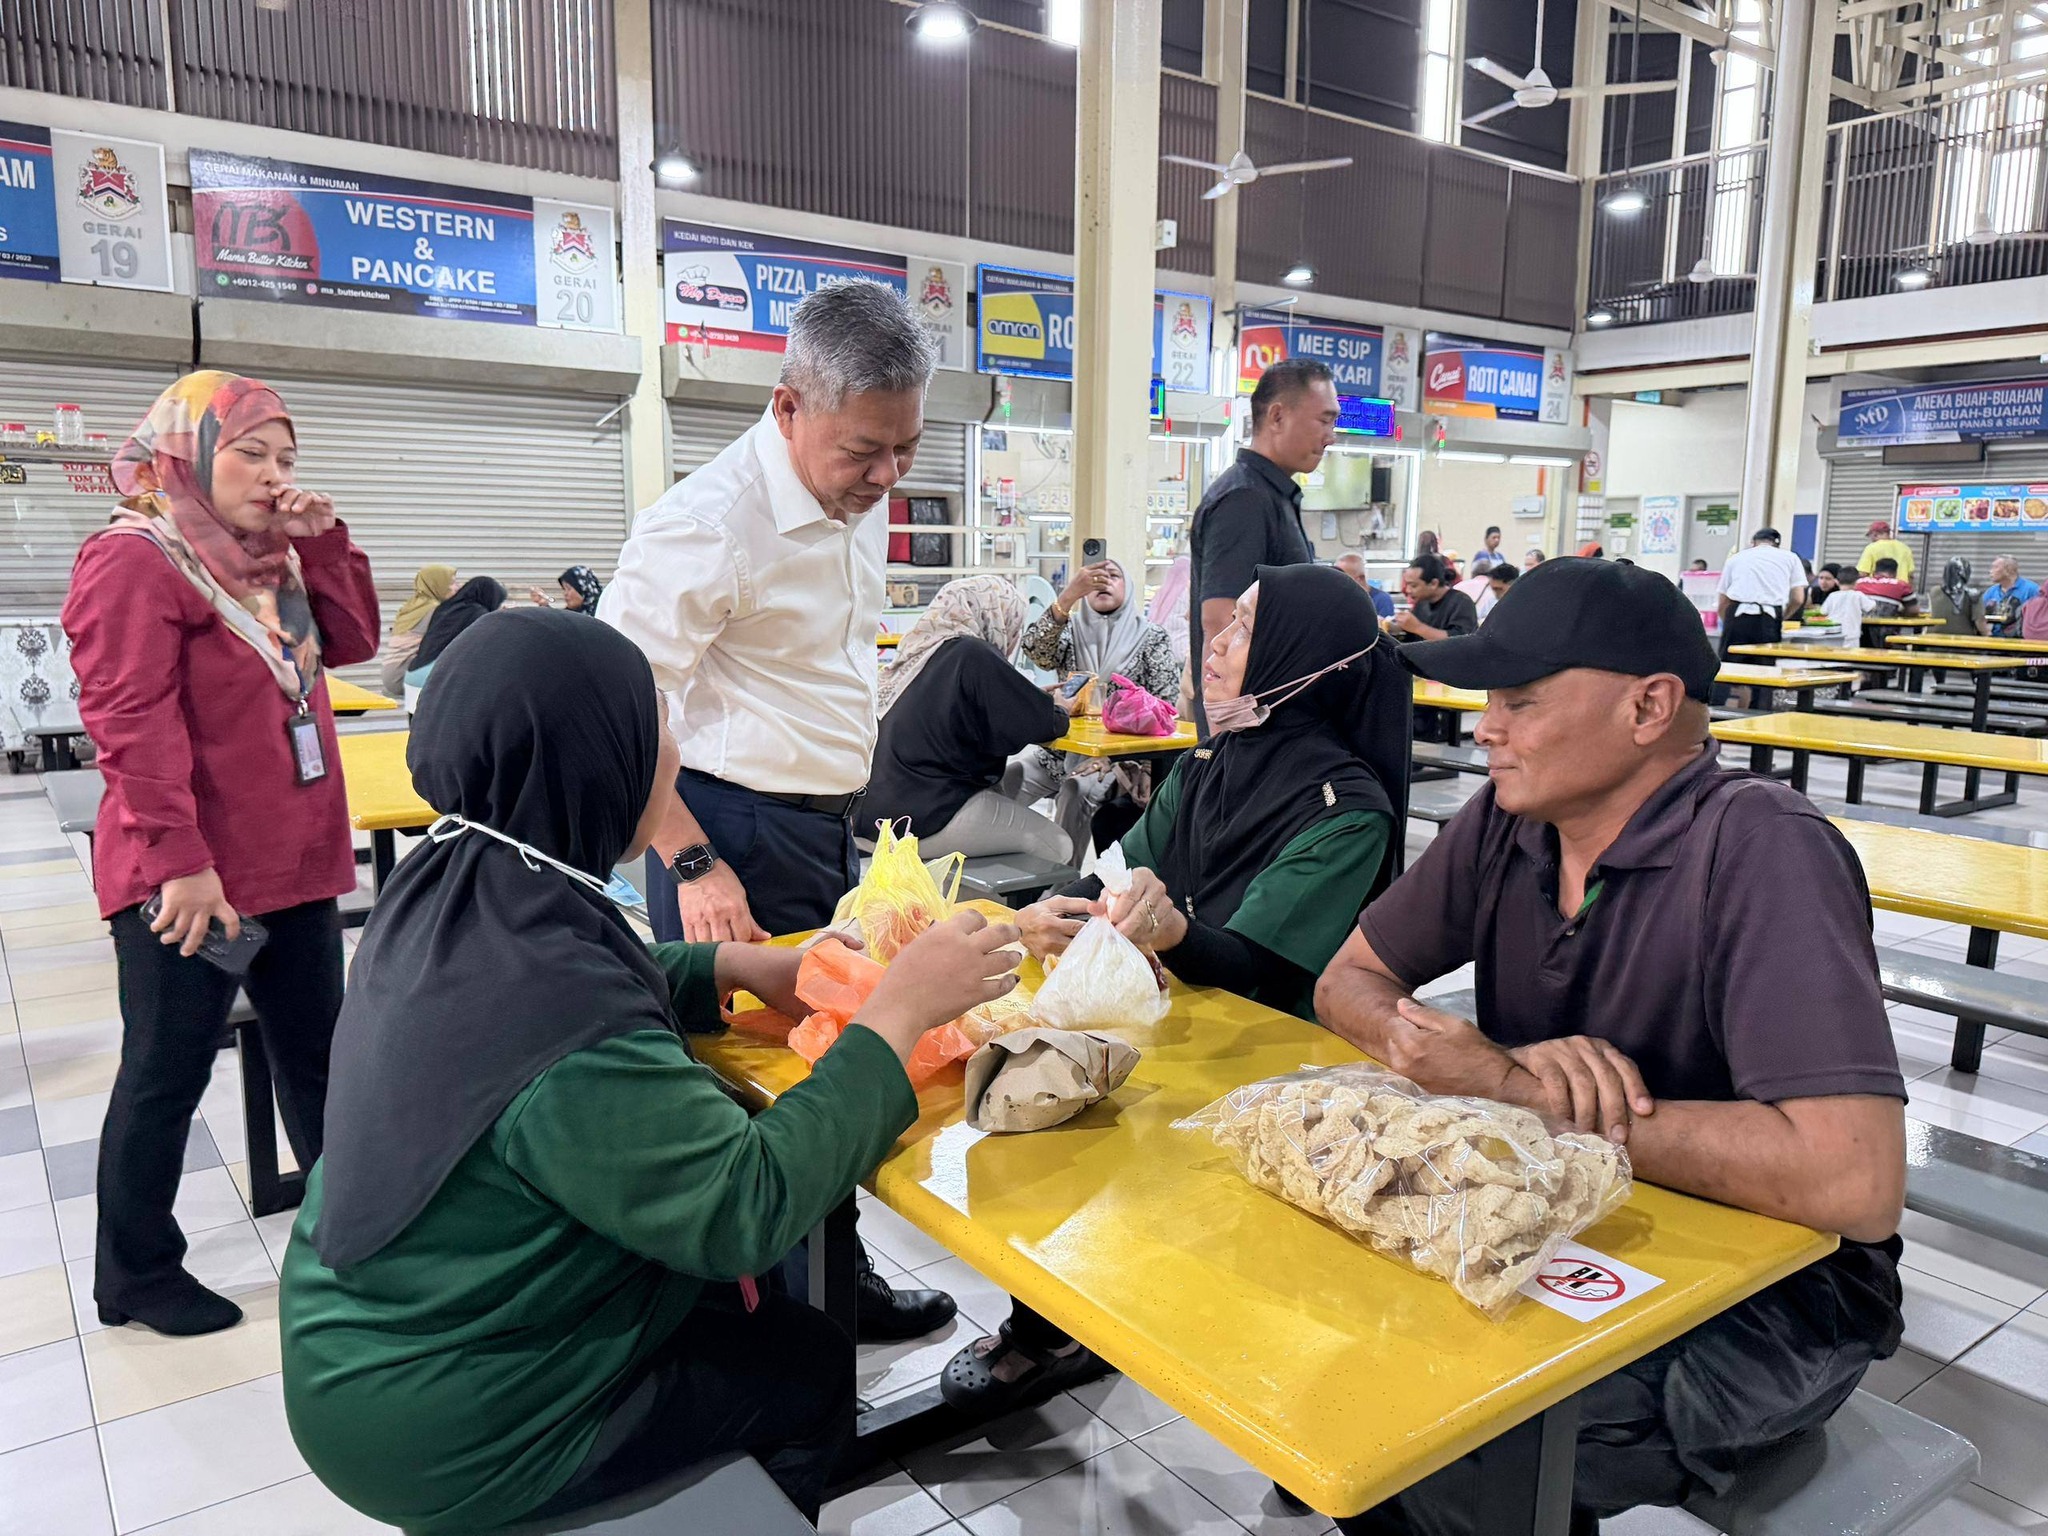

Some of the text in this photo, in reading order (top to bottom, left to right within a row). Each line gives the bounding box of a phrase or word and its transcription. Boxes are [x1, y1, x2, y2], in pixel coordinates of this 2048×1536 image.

[204, 162, 360, 192] GERAI MAKANAN & MINUMAN
[82, 220, 142, 240] GERAI
[344, 200, 496, 242] WESTERN
[413, 237, 435, 262] &
[673, 231, 755, 251] KEDAI ROTI DAN KEK
[91, 239, 138, 279] 19
[216, 248, 308, 269] Mama Butter Kitchen
[351, 257, 497, 294] PANCAKE
[554, 274, 597, 290] GERAI
[556, 290, 594, 323] 20
[987, 319, 1041, 340] amran
[1297, 333, 1371, 361] MEE SUP
[1171, 361, 1195, 386] 22
[1333, 363, 1372, 386] KARI
[1467, 364, 1539, 399] ROTI CANAI
[1546, 400, 1561, 421] 24
[1913, 387, 2044, 411] ANEKA BUAH-BUAHAN
[1911, 404, 2043, 423] JUS BUAH-BUAHAN
[1911, 420, 1958, 432] MINUMAN
[1959, 418, 1994, 430] PANAS
[2005, 415, 2041, 428] SEJUK
[62, 462, 88, 472] SUP
[66, 474, 93, 484] TOM
